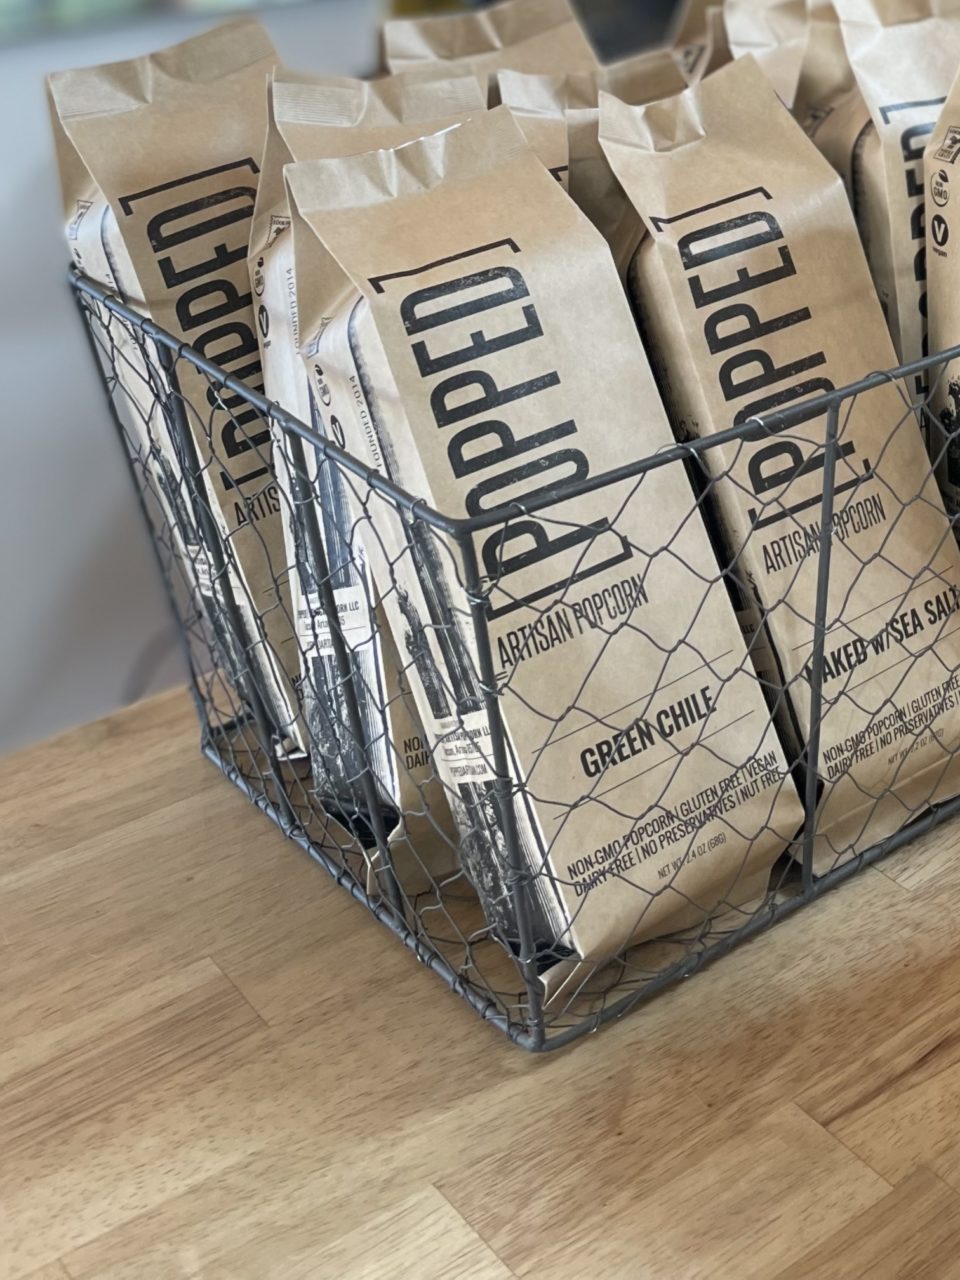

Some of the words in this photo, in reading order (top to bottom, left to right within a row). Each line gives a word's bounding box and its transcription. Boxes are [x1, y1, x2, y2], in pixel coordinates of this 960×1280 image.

[933, 187, 948, 200] GMO
[368, 237, 633, 622] [POPPED]
[762, 520, 821, 575] ARTISAN
[829, 493, 887, 544] OPCORN
[497, 608, 575, 669] ARTISAN
[572, 573, 650, 635] POPCORN
[580, 720, 656, 778] GREEN
[656, 685, 717, 739] CHILE
[826, 755, 854, 779] DAIRY
[854, 742, 876, 764] FREE
[879, 731, 893, 749] NO
[867, 708, 908, 740] POPCORN
[910, 688, 943, 713] GLUTEN
[567, 838, 622, 880] NON-GMO
[623, 812, 676, 850] POPCORN
[676, 784, 719, 819] GLUTEN
[718, 771, 742, 797] FREE
[745, 750, 778, 784] VEGAN
[573, 866, 609, 898] DAIRY
[610, 852, 637, 878] FREE
[641, 839, 659, 861] NO
[658, 793, 737, 851] PRESERVATIVES
[739, 782, 761, 807] NUT
[760, 767, 785, 790] FREE
[657, 864, 671, 880] NET
